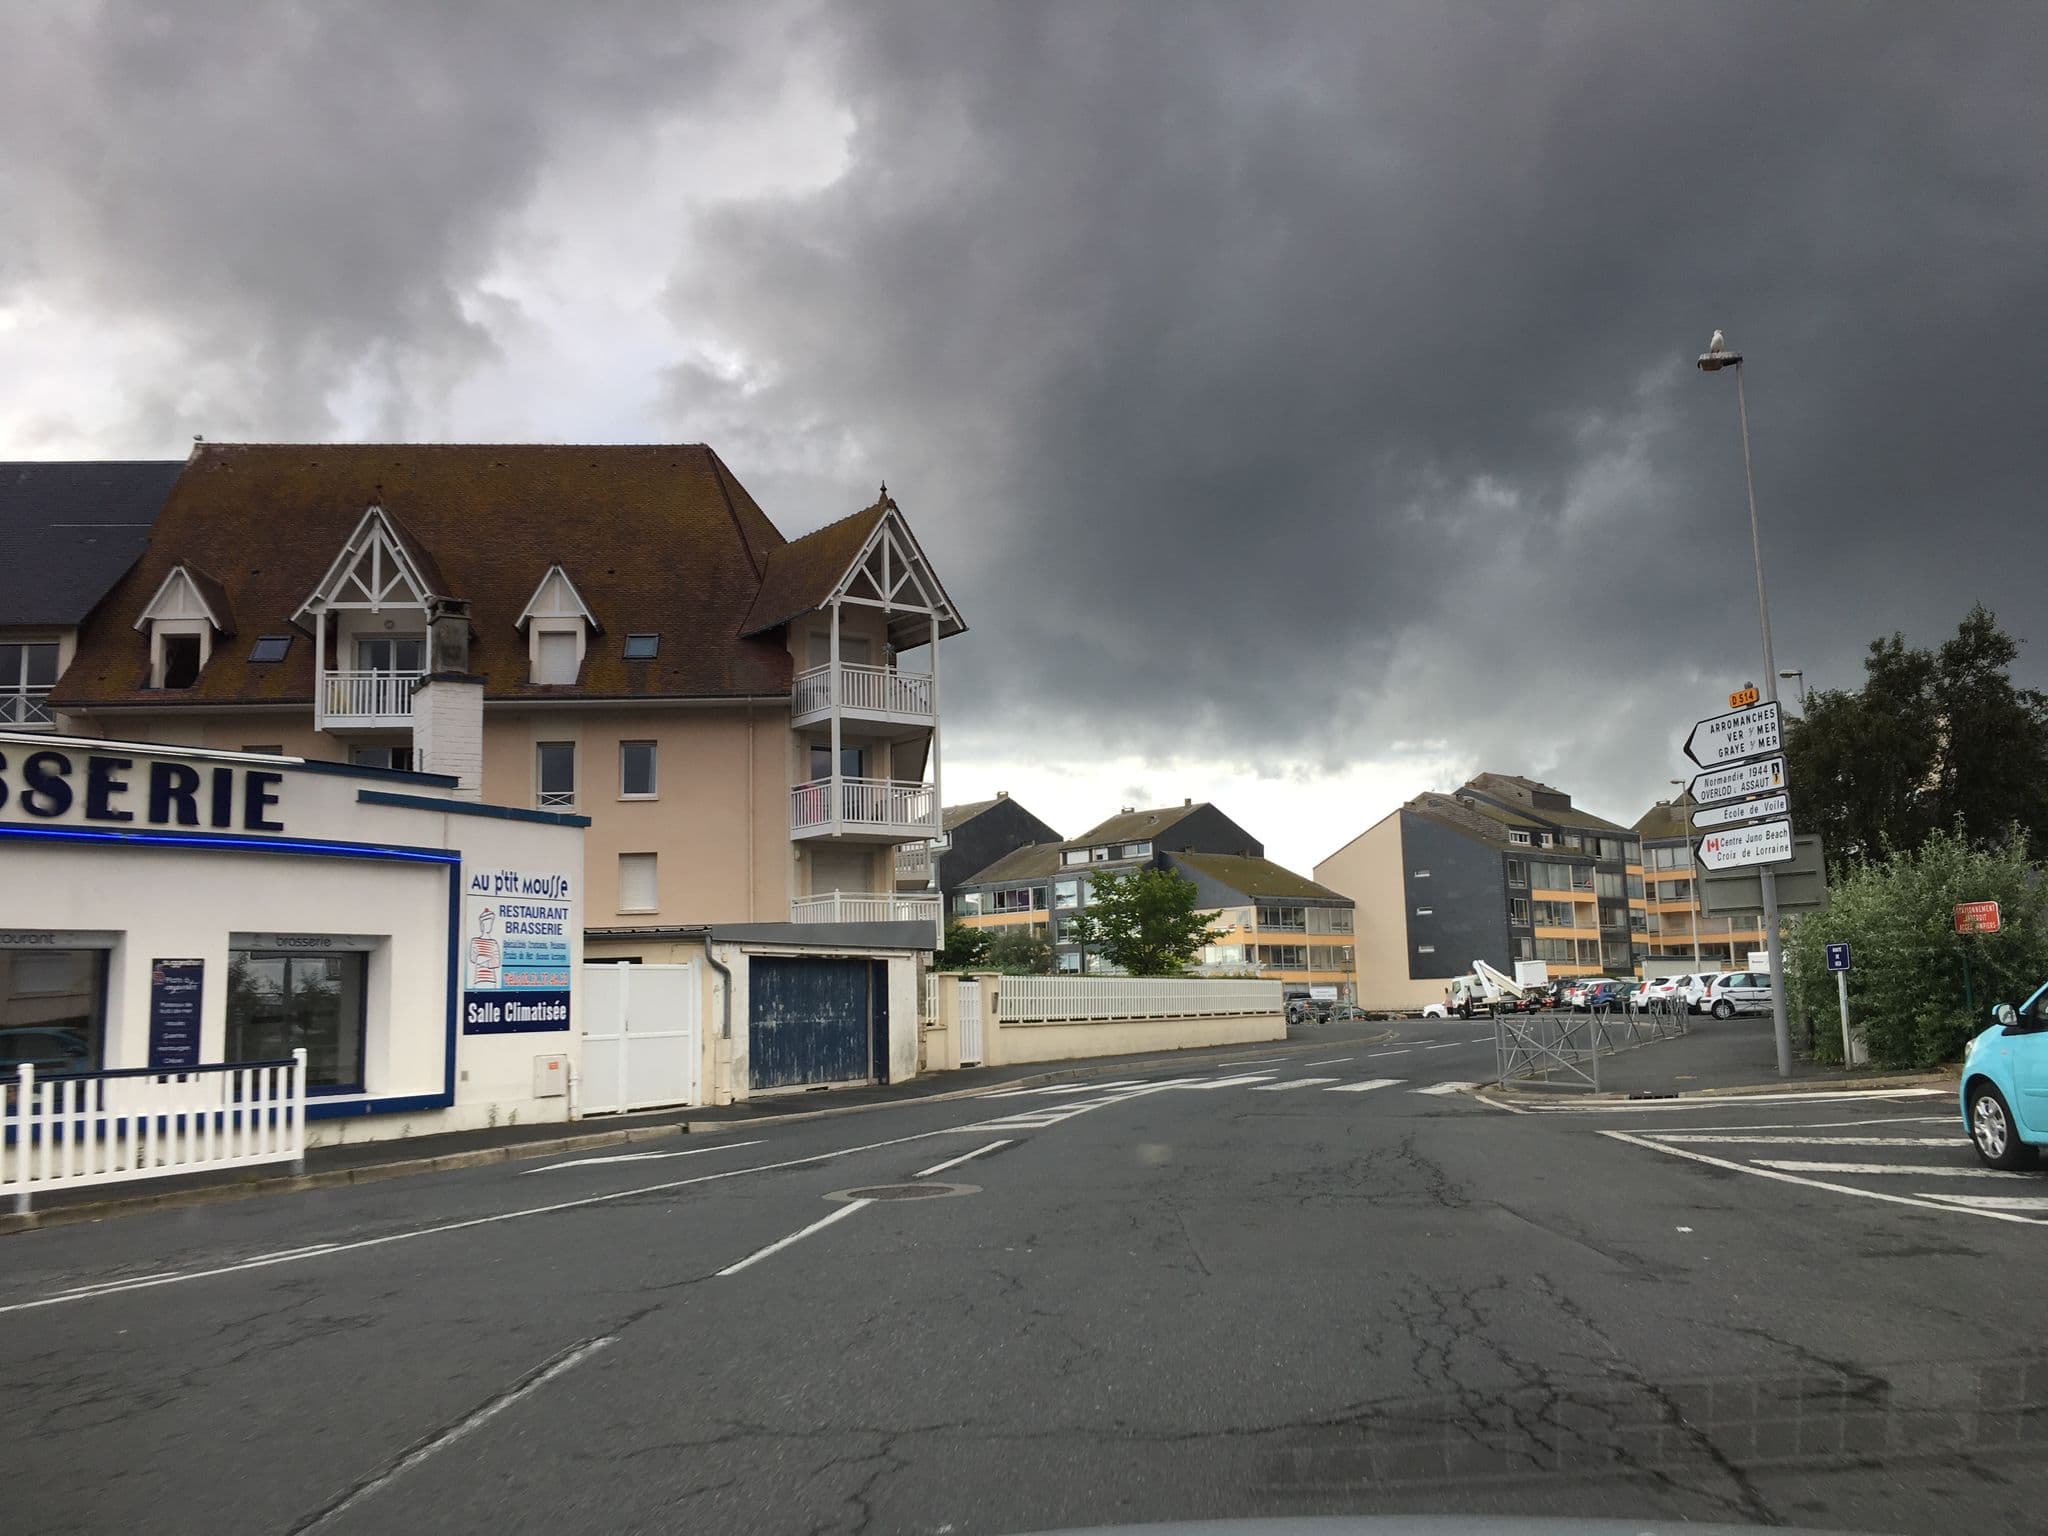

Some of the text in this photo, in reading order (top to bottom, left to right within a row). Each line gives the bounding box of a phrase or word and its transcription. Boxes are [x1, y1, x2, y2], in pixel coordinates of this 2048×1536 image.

[1731, 691, 1754, 706] D 514
[1710, 708, 1775, 734] ARROMANCHES
[1727, 730, 1744, 742] VER
[1757, 722, 1776, 735] MER
[1719, 743, 1745, 758] GRAYE
[1758, 735, 1778, 748] MER
[1704, 765, 1768, 787] Normandie 1944
[1741, 777, 1769, 792] ASSAUT
[0, 750, 284, 831] SERIE
[1724, 800, 1785, 819] École de Voile
[1720, 828, 1788, 848] Centre Juno Beach
[1717, 843, 1789, 861] Croix de Lorraine
[471, 874, 489, 891] AU
[499, 905, 568, 920] RESTAURANT
[505, 922, 563, 935] BRASSERIE
[276, 935, 331, 947] brasserie
[468, 1000, 567, 1024] Salle Climatisée
